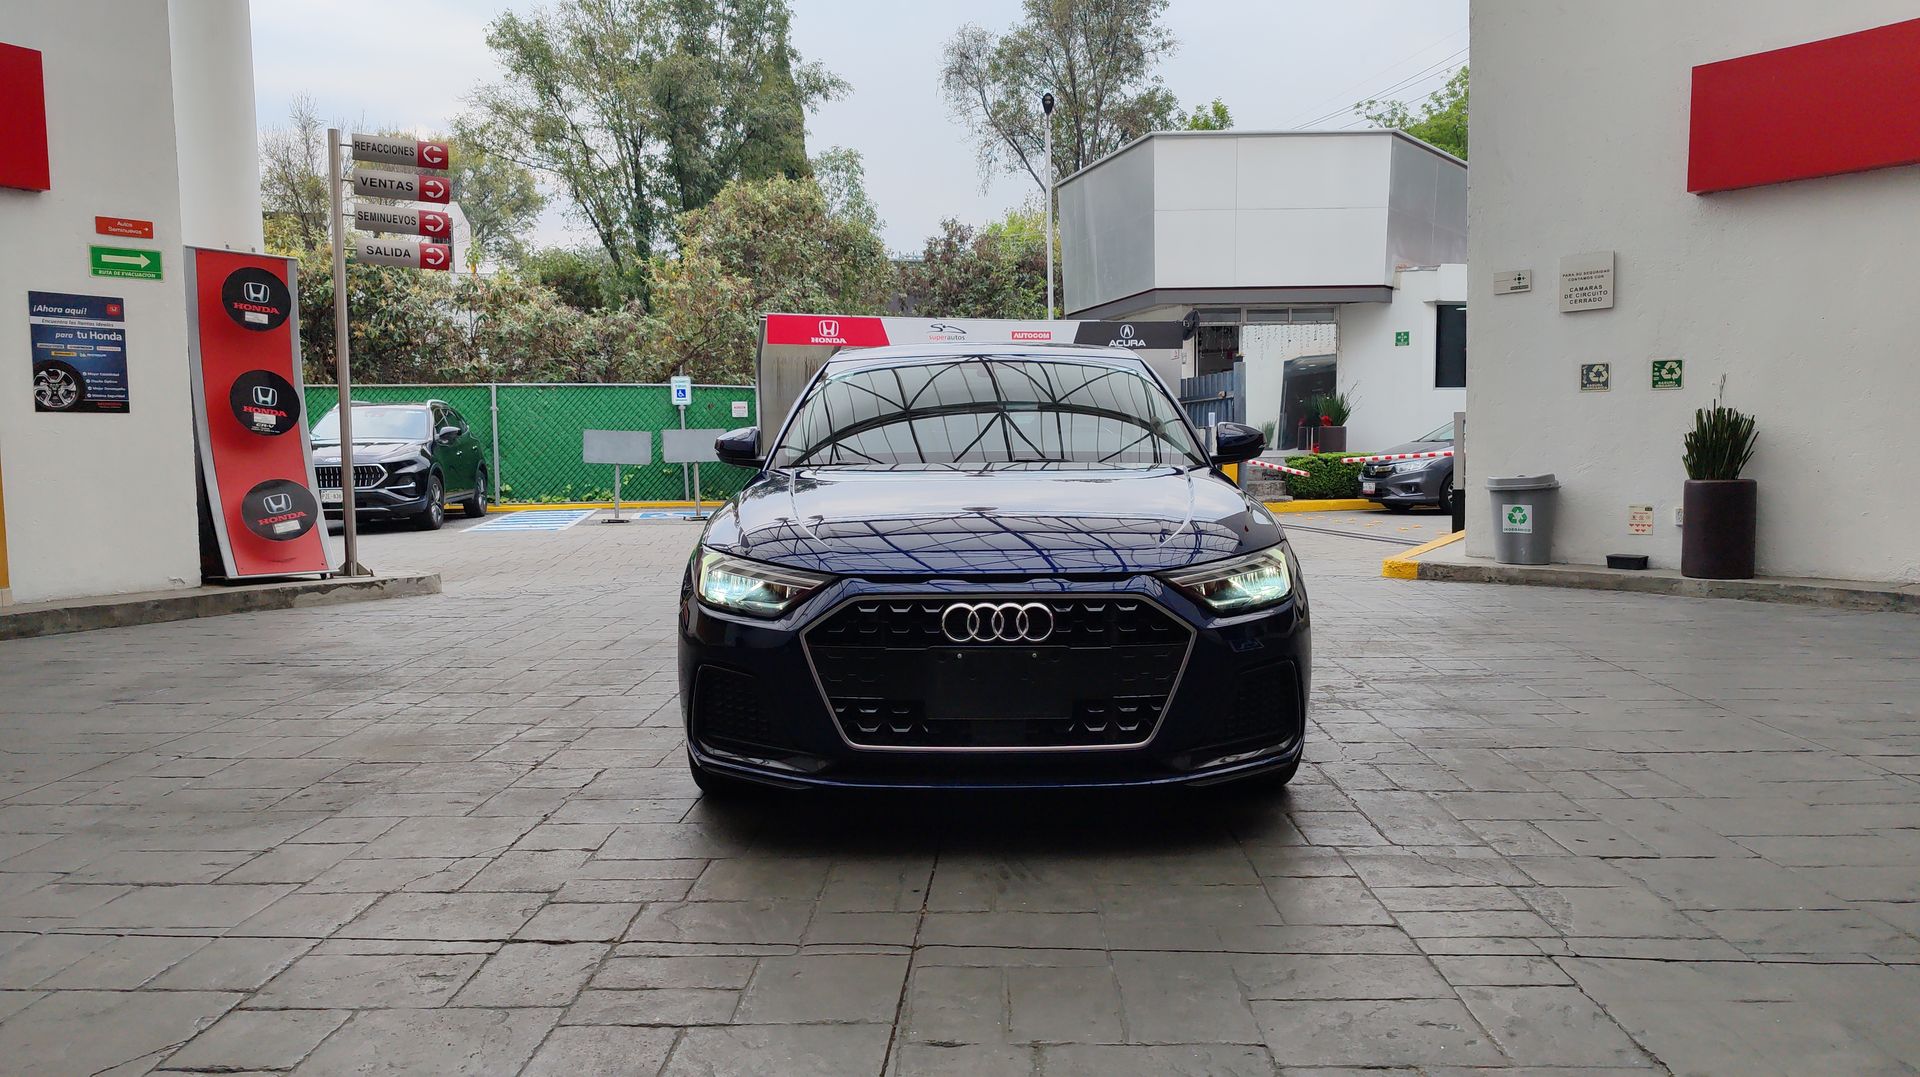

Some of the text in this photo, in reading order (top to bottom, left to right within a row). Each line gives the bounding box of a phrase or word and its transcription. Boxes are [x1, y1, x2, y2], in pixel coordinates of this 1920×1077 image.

[354, 141, 415, 156] REFACCIONES
[360, 177, 414, 191] VENTAS
[357, 210, 417, 226] SEMINUEVOS
[107, 226, 142, 234] Seminuevos
[366, 245, 411, 258] SALIDA
[1569, 284, 1603, 293] CAMARAS
[1575, 290, 1608, 298] CIRCUITO
[1569, 296, 1603, 305] CERRADO
[33, 304, 87, 316] ¡Ahora aquí!
[233, 302, 280, 315] HONDA
[76, 331, 87, 339] tu
[89, 331, 122, 341] Honda
[242, 405, 288, 417] HONDA
[257, 511, 308, 525] HONDA
